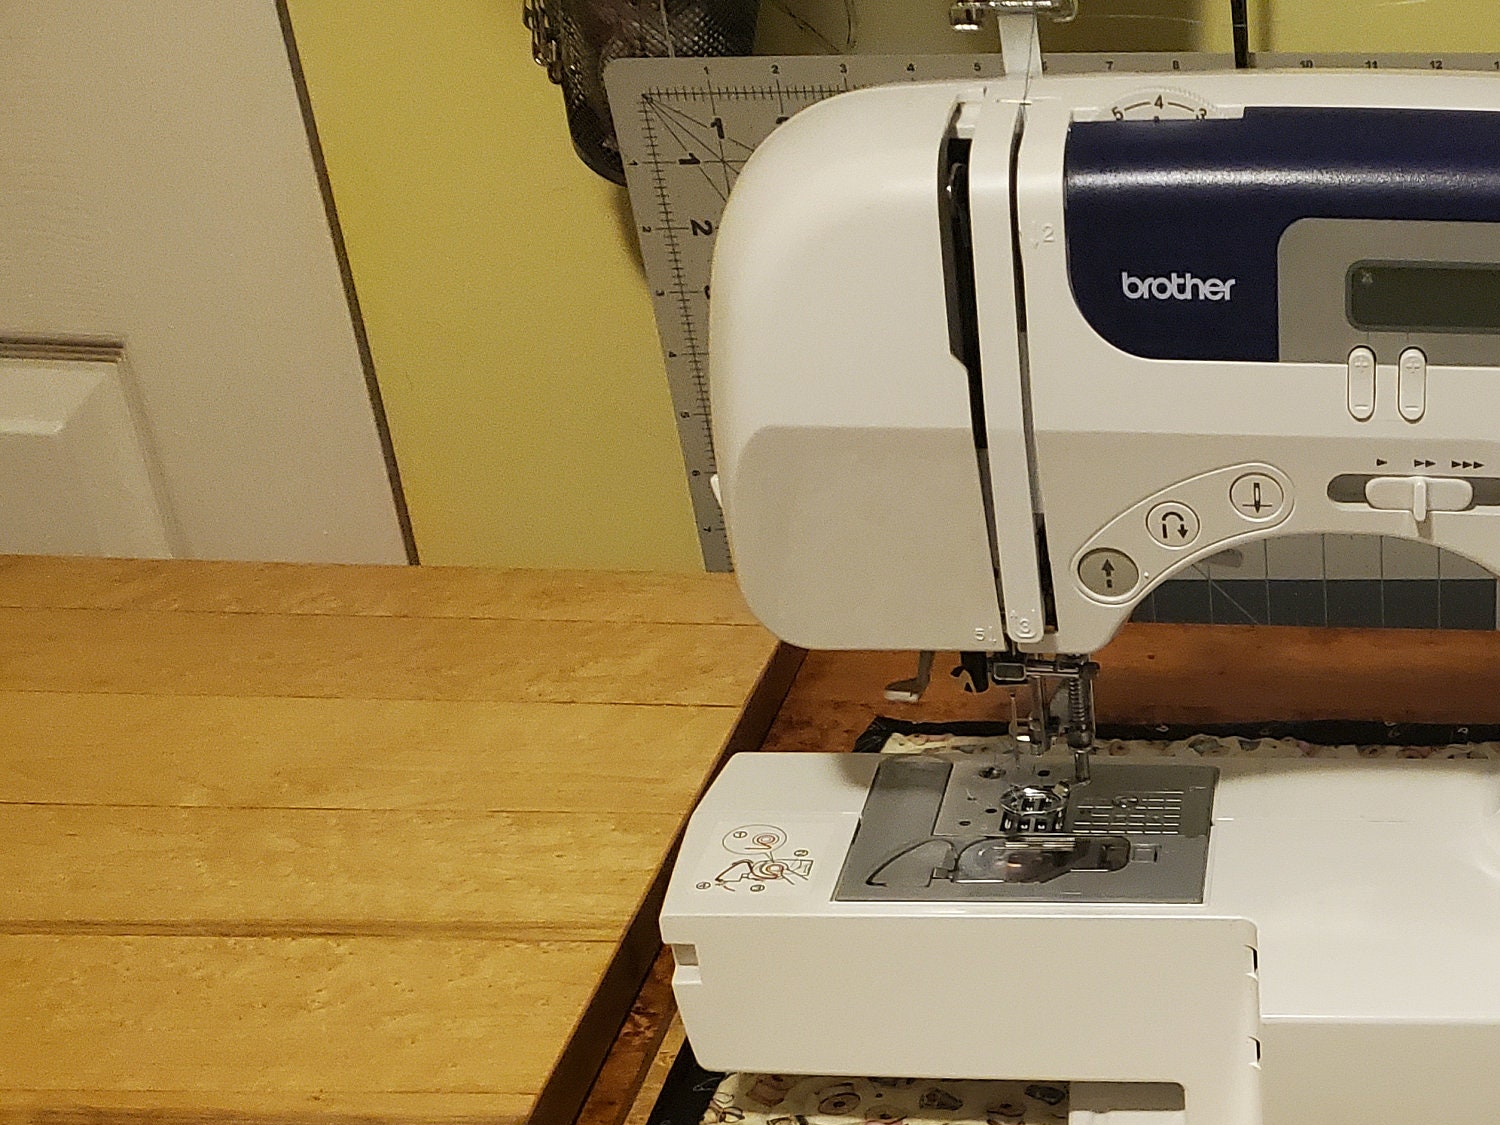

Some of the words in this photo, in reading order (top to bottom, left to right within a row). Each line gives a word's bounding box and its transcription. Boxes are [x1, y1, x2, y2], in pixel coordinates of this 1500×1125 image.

[770, 64, 780, 74] 2
[839, 63, 848, 74] 3
[906, 62, 915, 71] 4
[973, 62, 982, 71] 5
[1105, 61, 1114, 71] 7
[1172, 60, 1180, 70] 8
[1364, 60, 1378, 69] 11
[1429, 60, 1443, 69] 12
[1153, 94, 1164, 109] 4
[710, 117, 725, 139] 1
[678, 152, 701, 165] 1
[690, 219, 713, 236] 2
[1042, 225, 1055, 243] 2
[642, 225, 652, 233] 2
[668, 350, 677, 358] 4
[1121, 272, 1236, 300] brother
